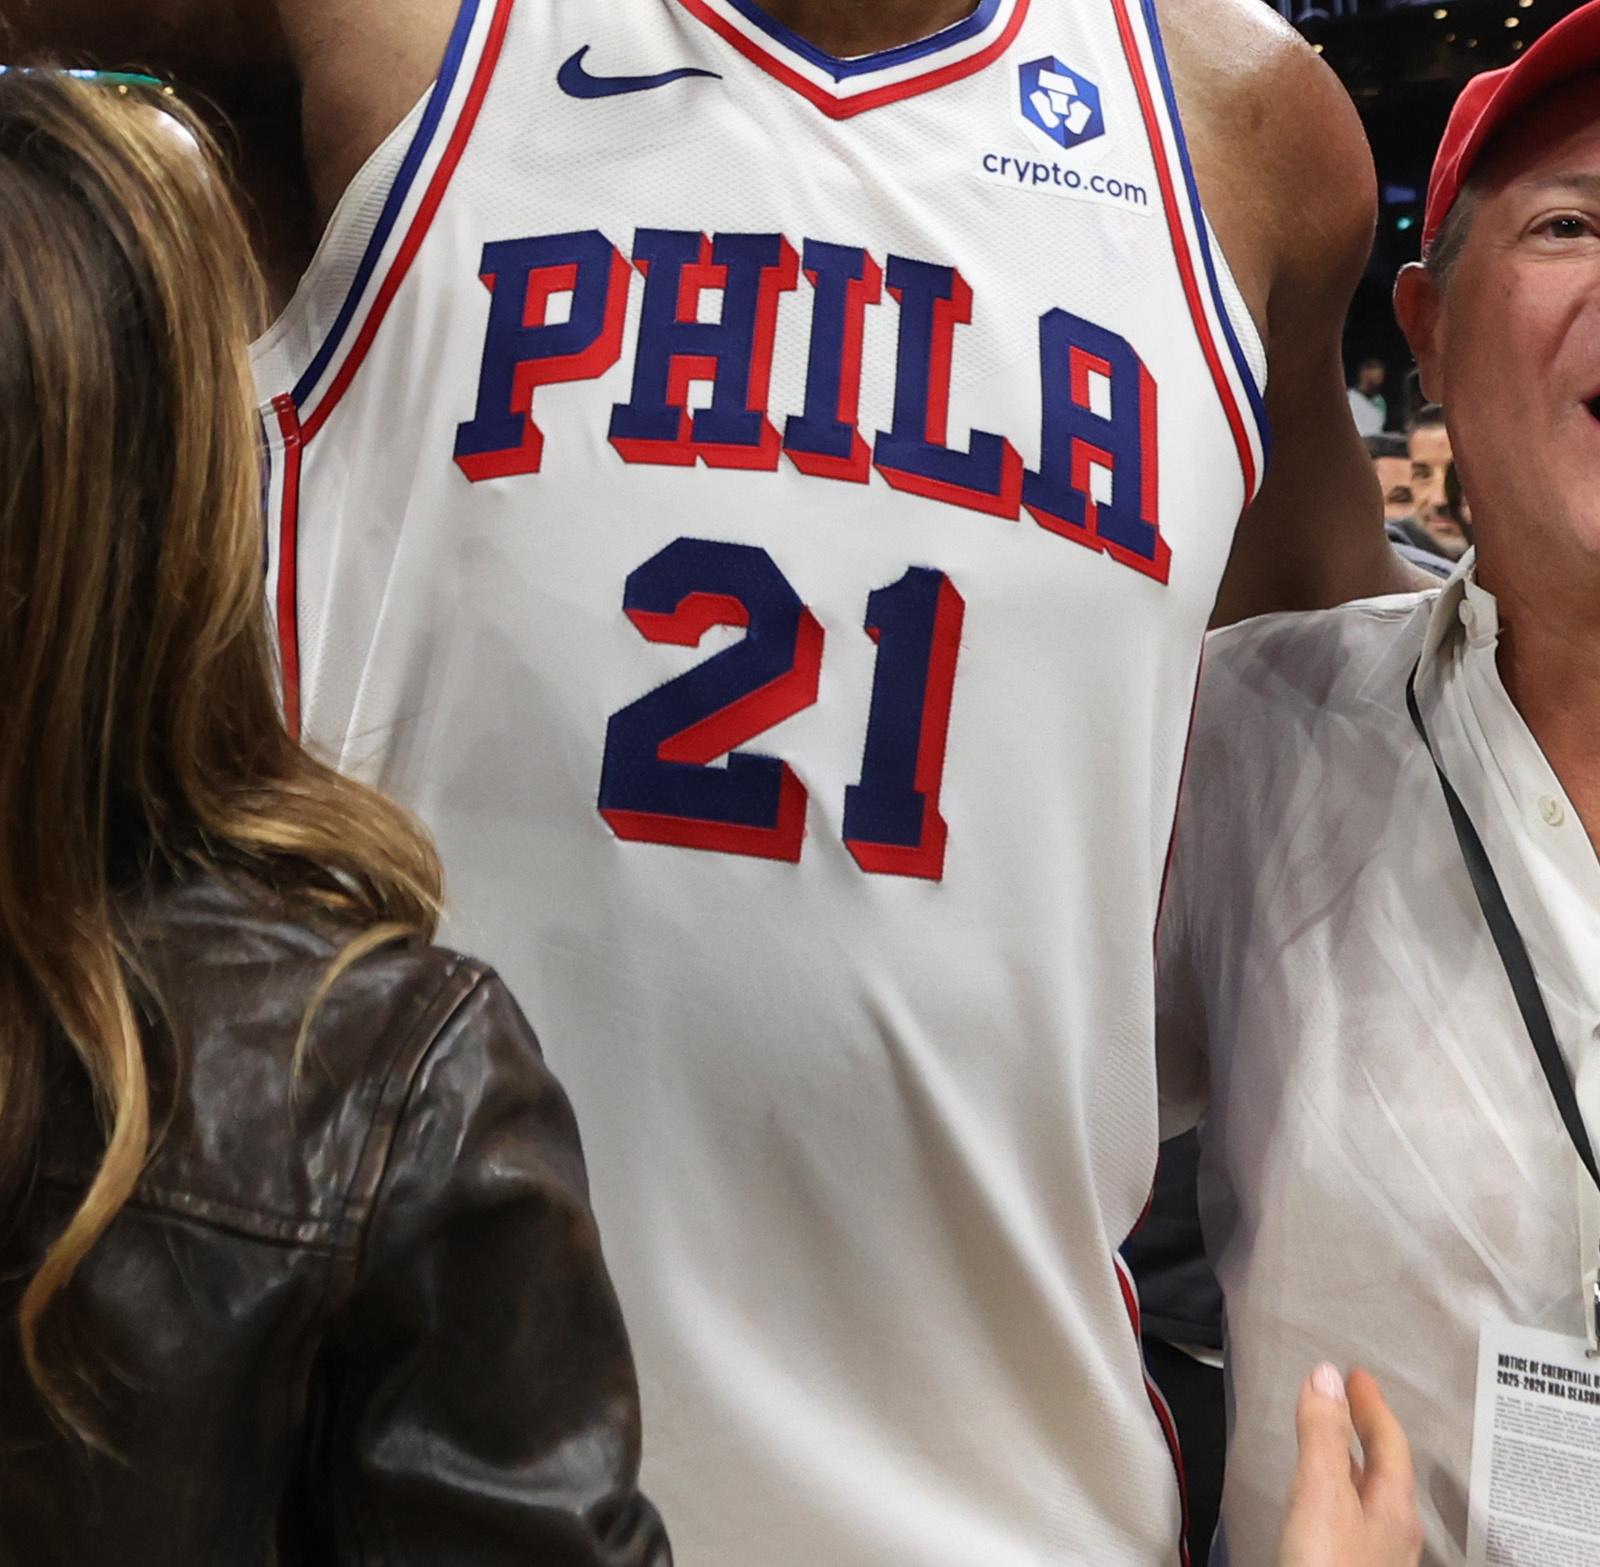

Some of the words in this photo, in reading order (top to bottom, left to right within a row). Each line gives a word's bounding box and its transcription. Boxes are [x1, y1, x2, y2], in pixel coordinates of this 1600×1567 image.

[982, 153, 1148, 206] crypto.com
[453, 228, 1171, 585] PHILA
[598, 537, 966, 882] 21
[1496, 1370, 1546, 1394] 2025-2026
[1547, 1381, 1566, 1400] NBA
[1498, 1353, 1527, 1374] NOTICE
[1529, 1360, 1540, 1375] OF
[1541, 1363, 1592, 1386] CREDENTIAL
